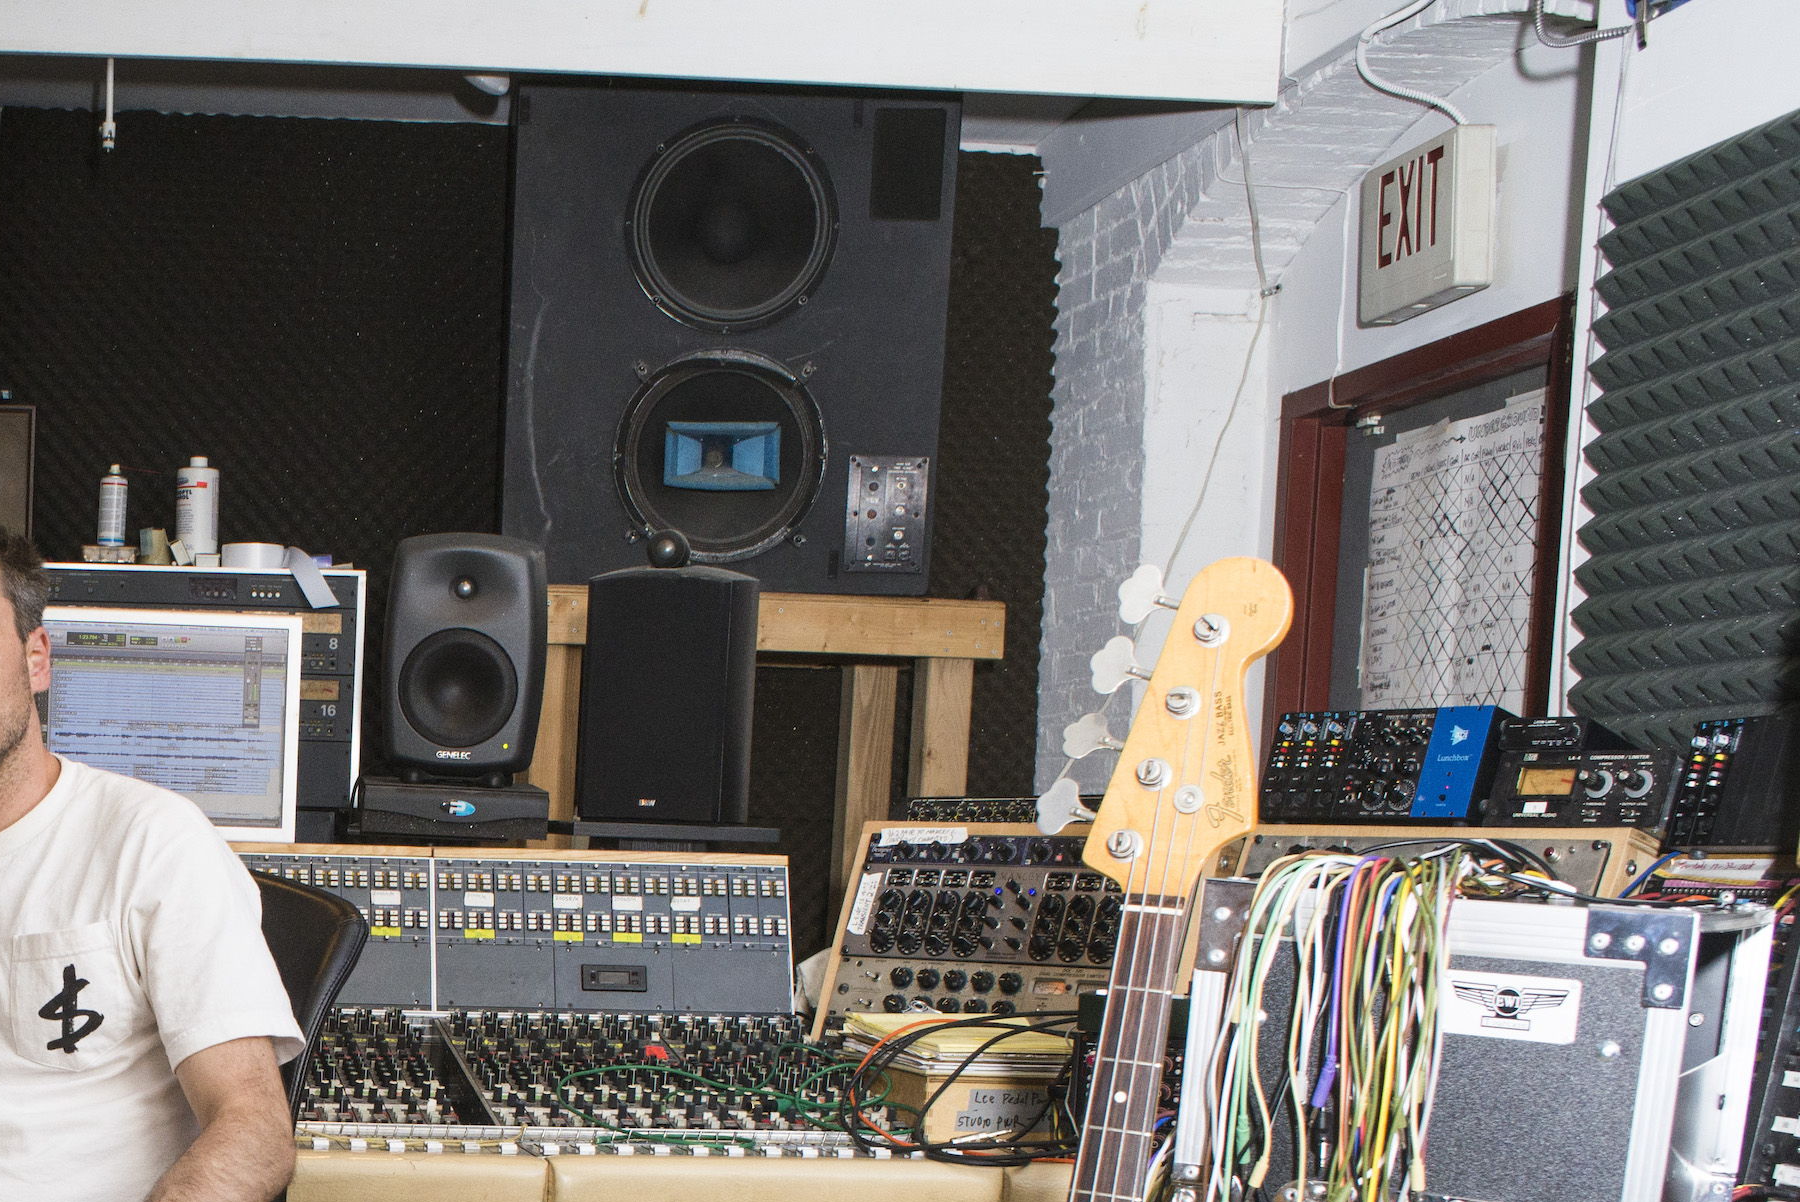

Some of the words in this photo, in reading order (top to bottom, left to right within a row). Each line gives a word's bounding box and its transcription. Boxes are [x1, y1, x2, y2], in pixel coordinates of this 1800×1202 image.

[1375, 144, 1445, 270] EXIT
[328, 637, 339, 650] 8
[320, 704, 338, 717] 16
[1214, 690, 1224, 717] BASS
[1216, 719, 1227, 747] JAZZ
[435, 750, 472, 761] GENELEC
[1436, 753, 1470, 762] Lunchbox
[1206, 753, 1245, 829] Fender
[1495, 994, 1520, 1009] EWI
[974, 1091, 995, 1104] Lee
[957, 1115, 992, 1129] STUDIO
